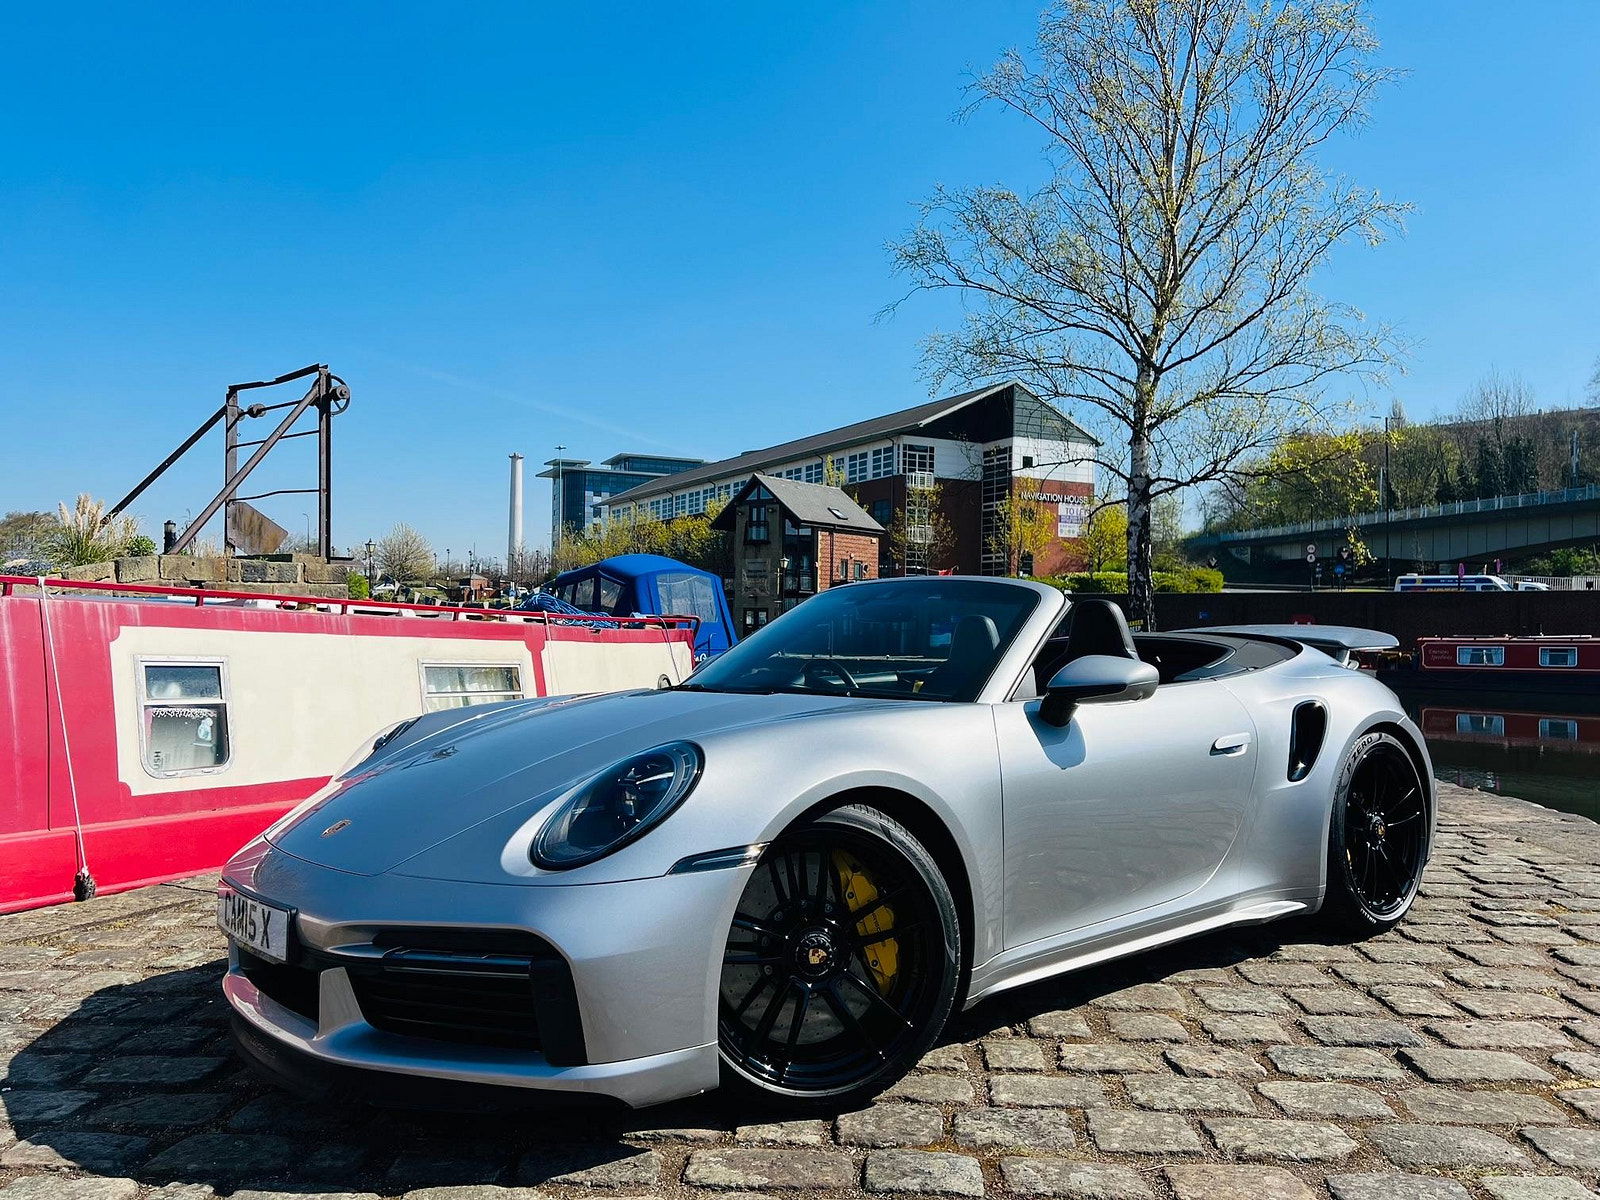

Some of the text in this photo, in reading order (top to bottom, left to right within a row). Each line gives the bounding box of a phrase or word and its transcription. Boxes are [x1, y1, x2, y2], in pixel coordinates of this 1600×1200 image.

[1020, 491, 1088, 504] NAVIGATION HOUSE
[1346, 736, 1373, 774] P ZERO
[260, 907, 272, 949] X
